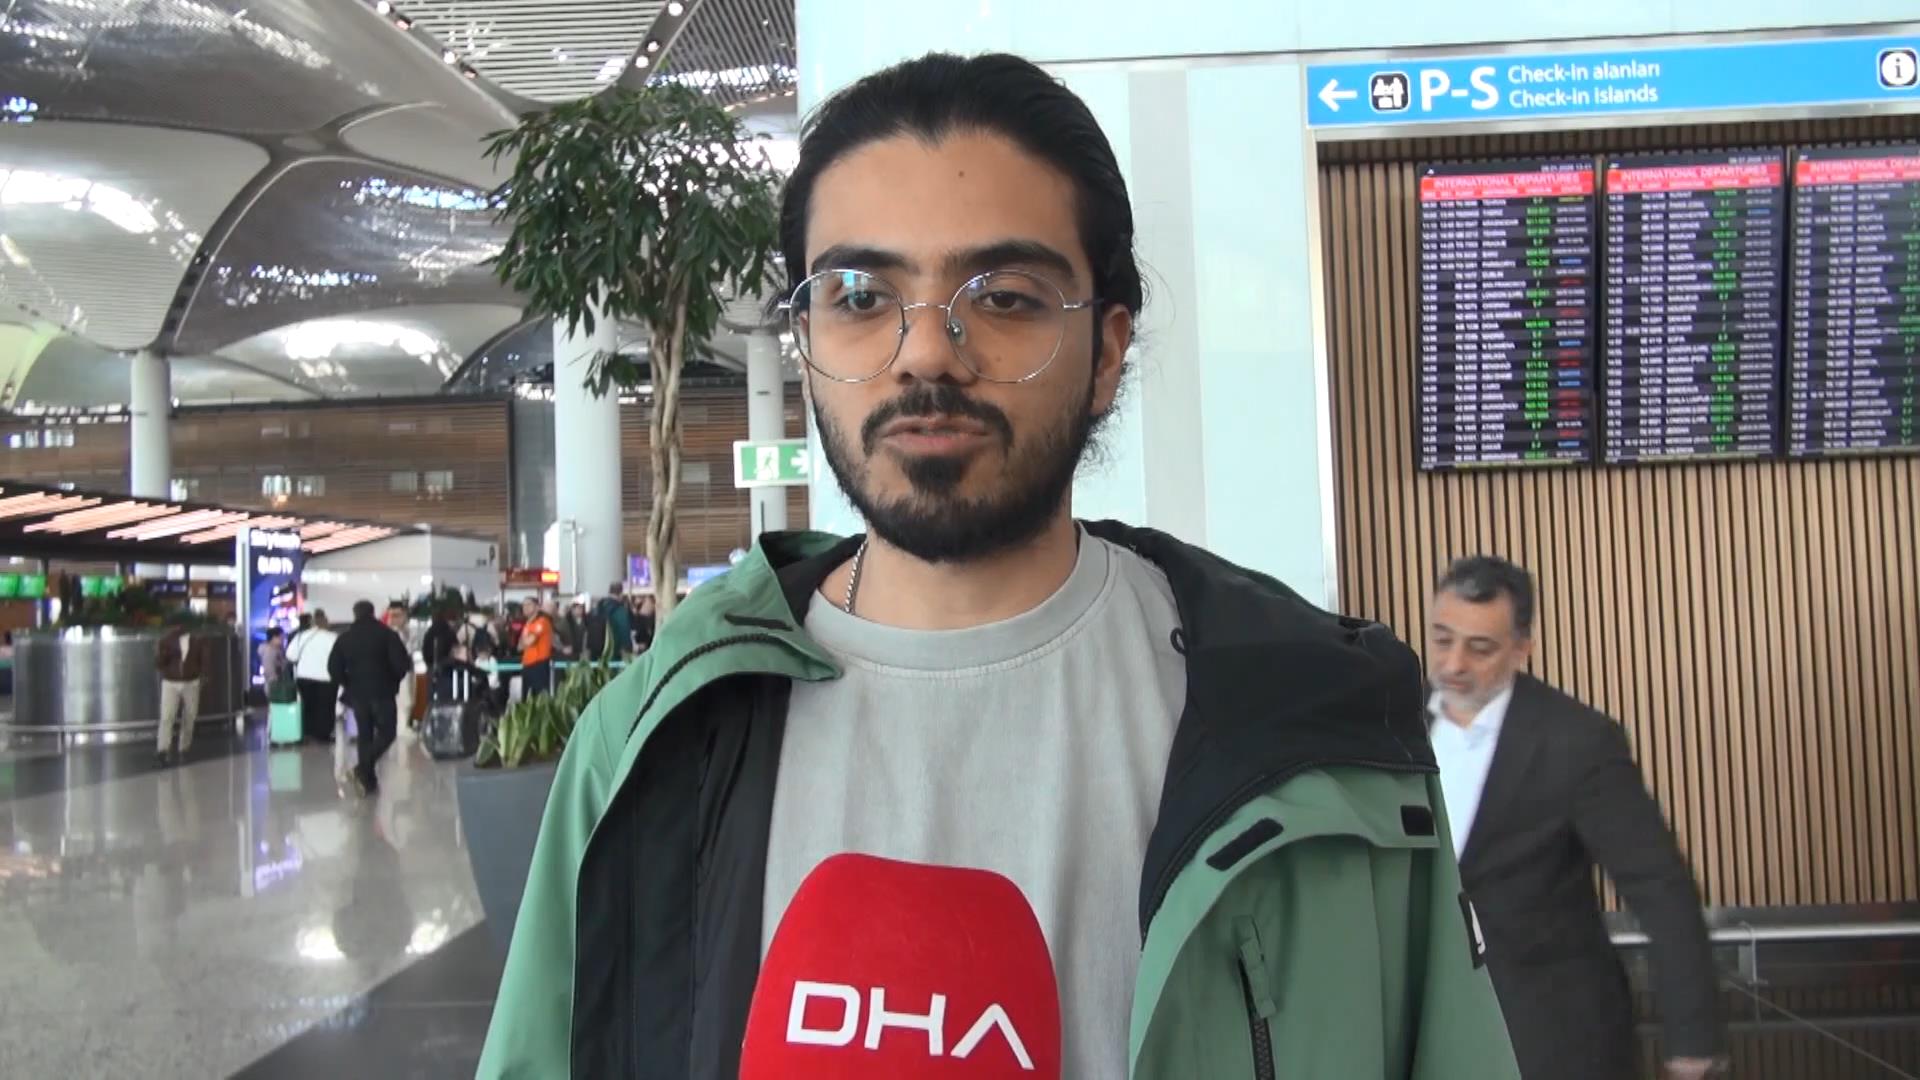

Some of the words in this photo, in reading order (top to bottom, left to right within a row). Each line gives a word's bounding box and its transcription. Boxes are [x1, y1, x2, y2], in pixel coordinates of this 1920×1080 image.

[1419, 66, 1499, 112] P-S
[1508, 62, 1589, 84] Check-in
[1592, 60, 1661, 81] alanları
[1508, 86, 1590, 108] Check-in
[1594, 84, 1658, 103] islands
[786, 980, 1035, 1070] DHA
